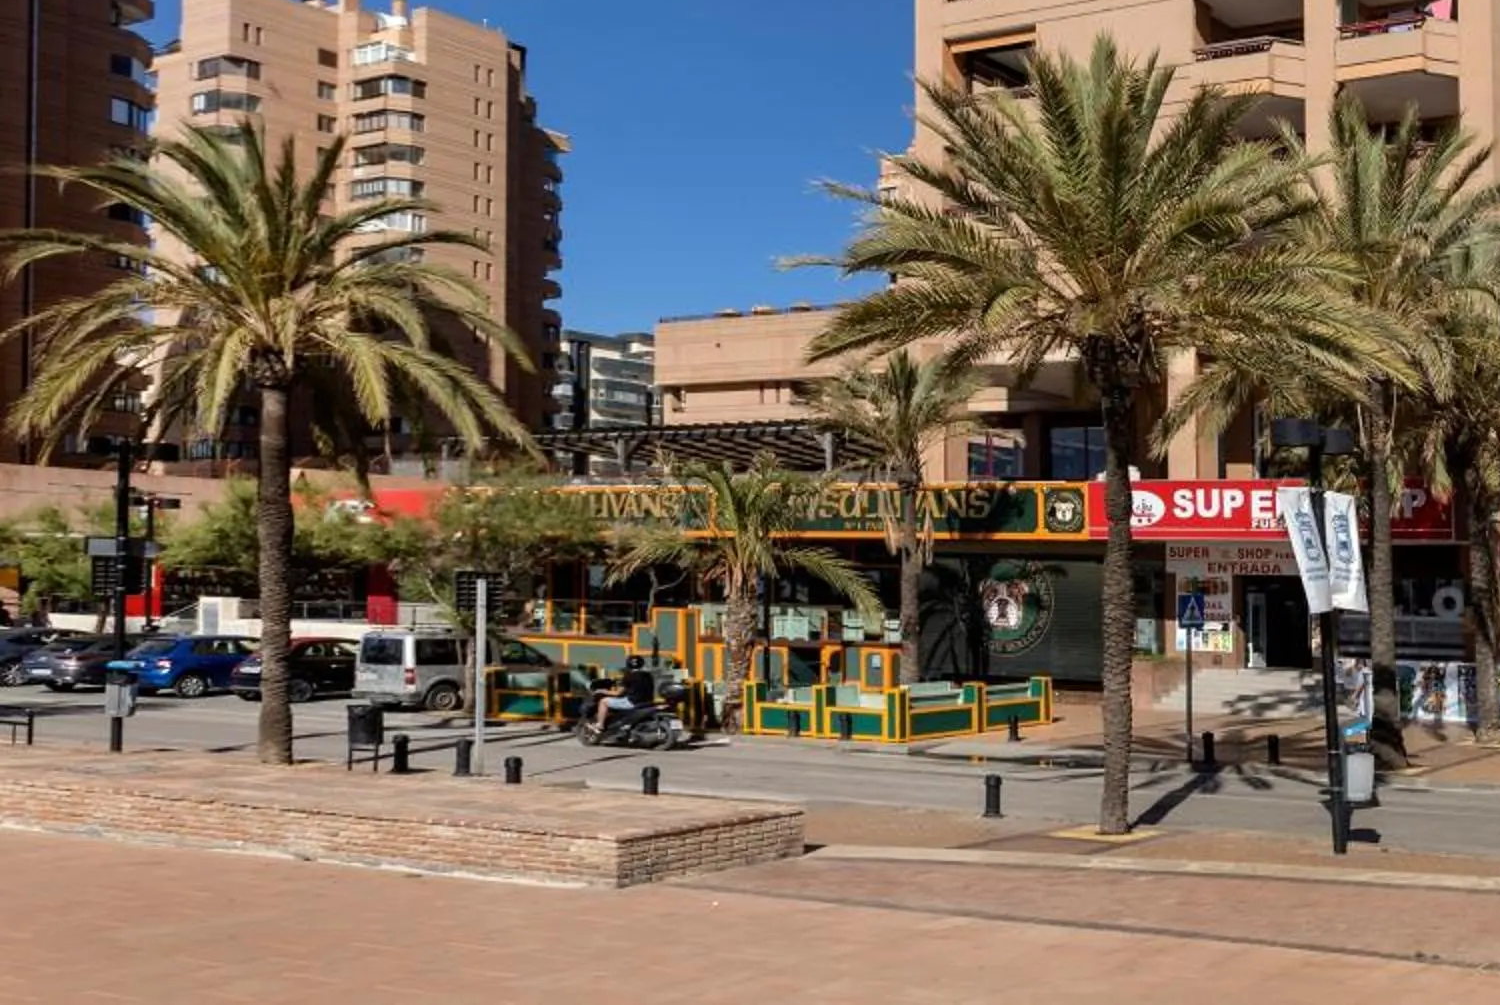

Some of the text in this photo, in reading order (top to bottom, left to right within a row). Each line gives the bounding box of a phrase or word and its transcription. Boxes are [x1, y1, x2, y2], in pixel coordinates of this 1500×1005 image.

[821, 488, 993, 520] SULLIANS
[1169, 547, 1210, 560] SUPER
[1237, 548, 1273, 560] SHOP
[1207, 562, 1281, 574] ENTRADA
